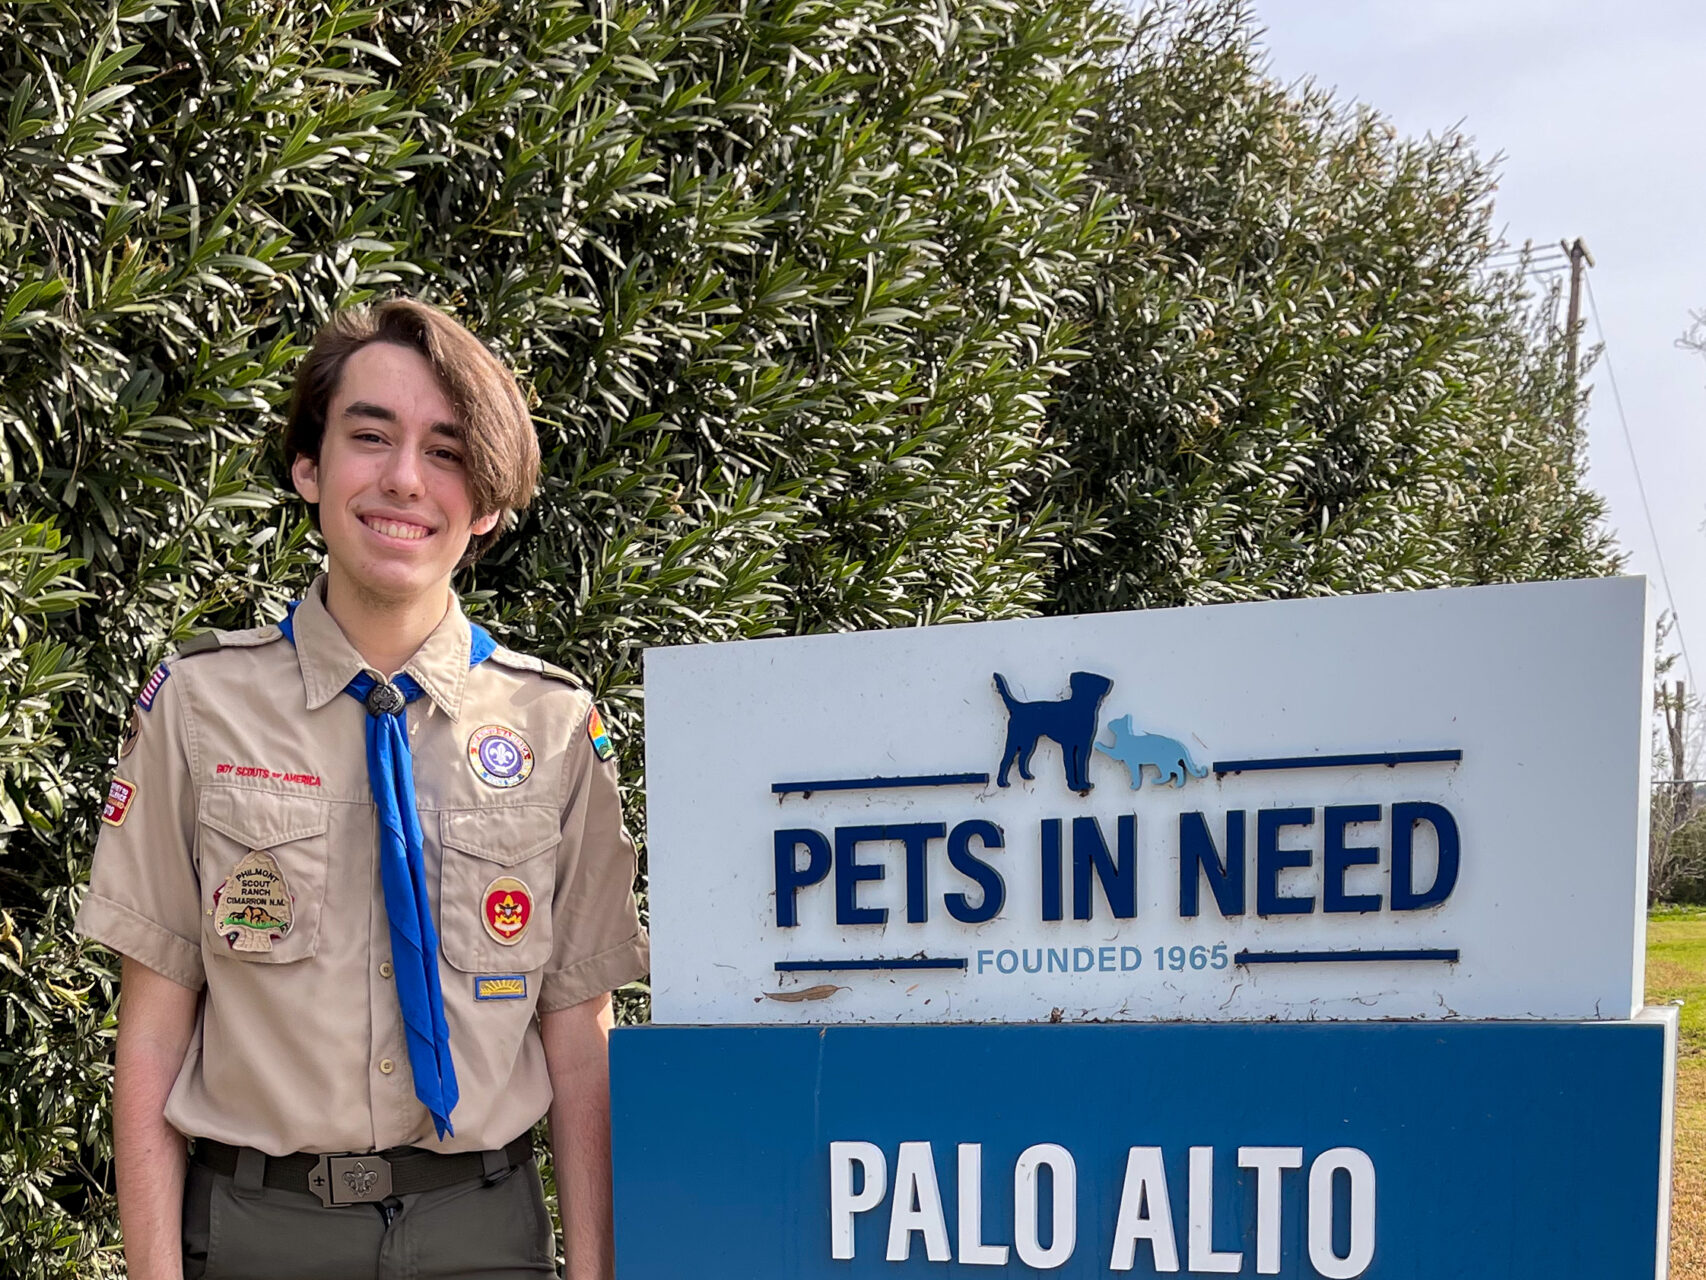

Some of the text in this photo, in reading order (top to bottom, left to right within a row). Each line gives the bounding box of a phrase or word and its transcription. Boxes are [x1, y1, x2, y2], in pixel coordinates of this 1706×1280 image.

[216, 763, 233, 774] BOY
[235, 766, 270, 779] SCOUTS
[283, 773, 322, 787] AMERICA
[772, 801, 1462, 928] PETS IN NEED
[235, 868, 280, 883] PHILMONT
[241, 879, 271, 888] SCOUT
[226, 897, 267, 906] CIMARRON
[241, 888, 271, 896] RANCH
[977, 943, 1229, 975] FOUNDED 1965
[829, 1140, 1377, 1280] PALO ALTO
